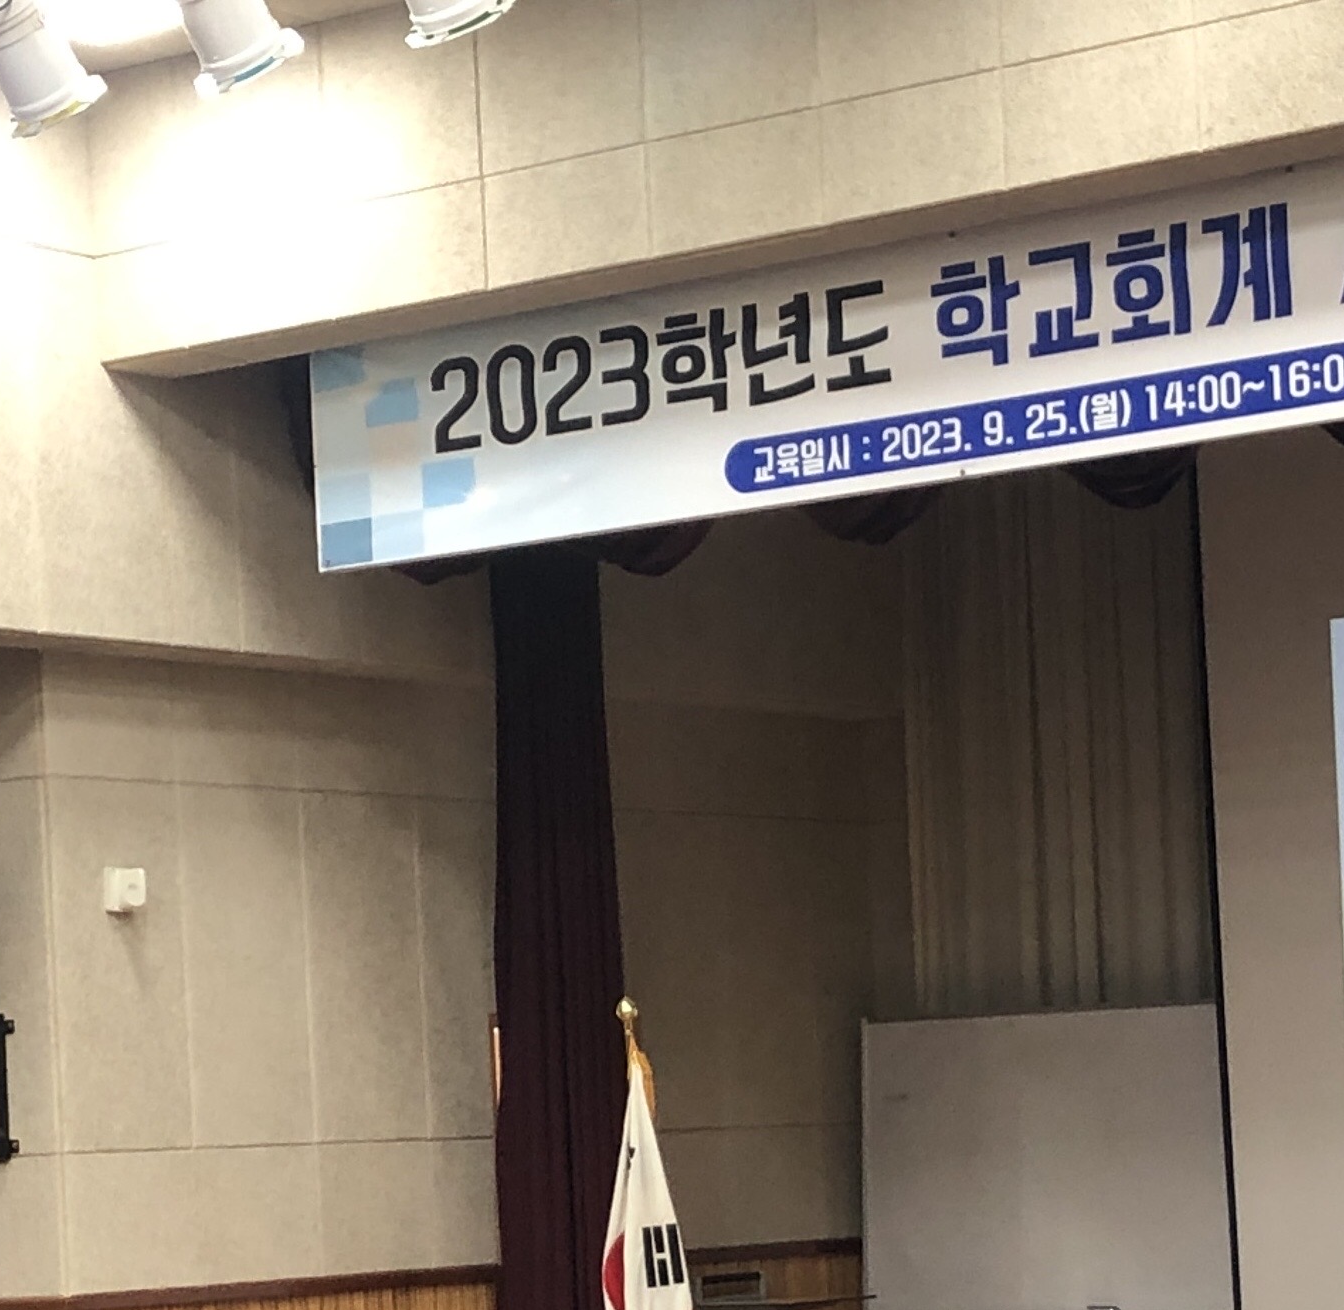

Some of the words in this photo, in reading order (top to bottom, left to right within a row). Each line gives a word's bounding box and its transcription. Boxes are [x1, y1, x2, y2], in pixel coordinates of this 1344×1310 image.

[430, 280, 892, 454] 2023학년도
[930, 203, 1293, 366] 학교회계
[753, 434, 851, 484] 교육일시
[882, 417, 972, 463] 2023.
[983, 410, 1014, 446] 9.
[1025, 389, 1132, 441] 25.(월)
